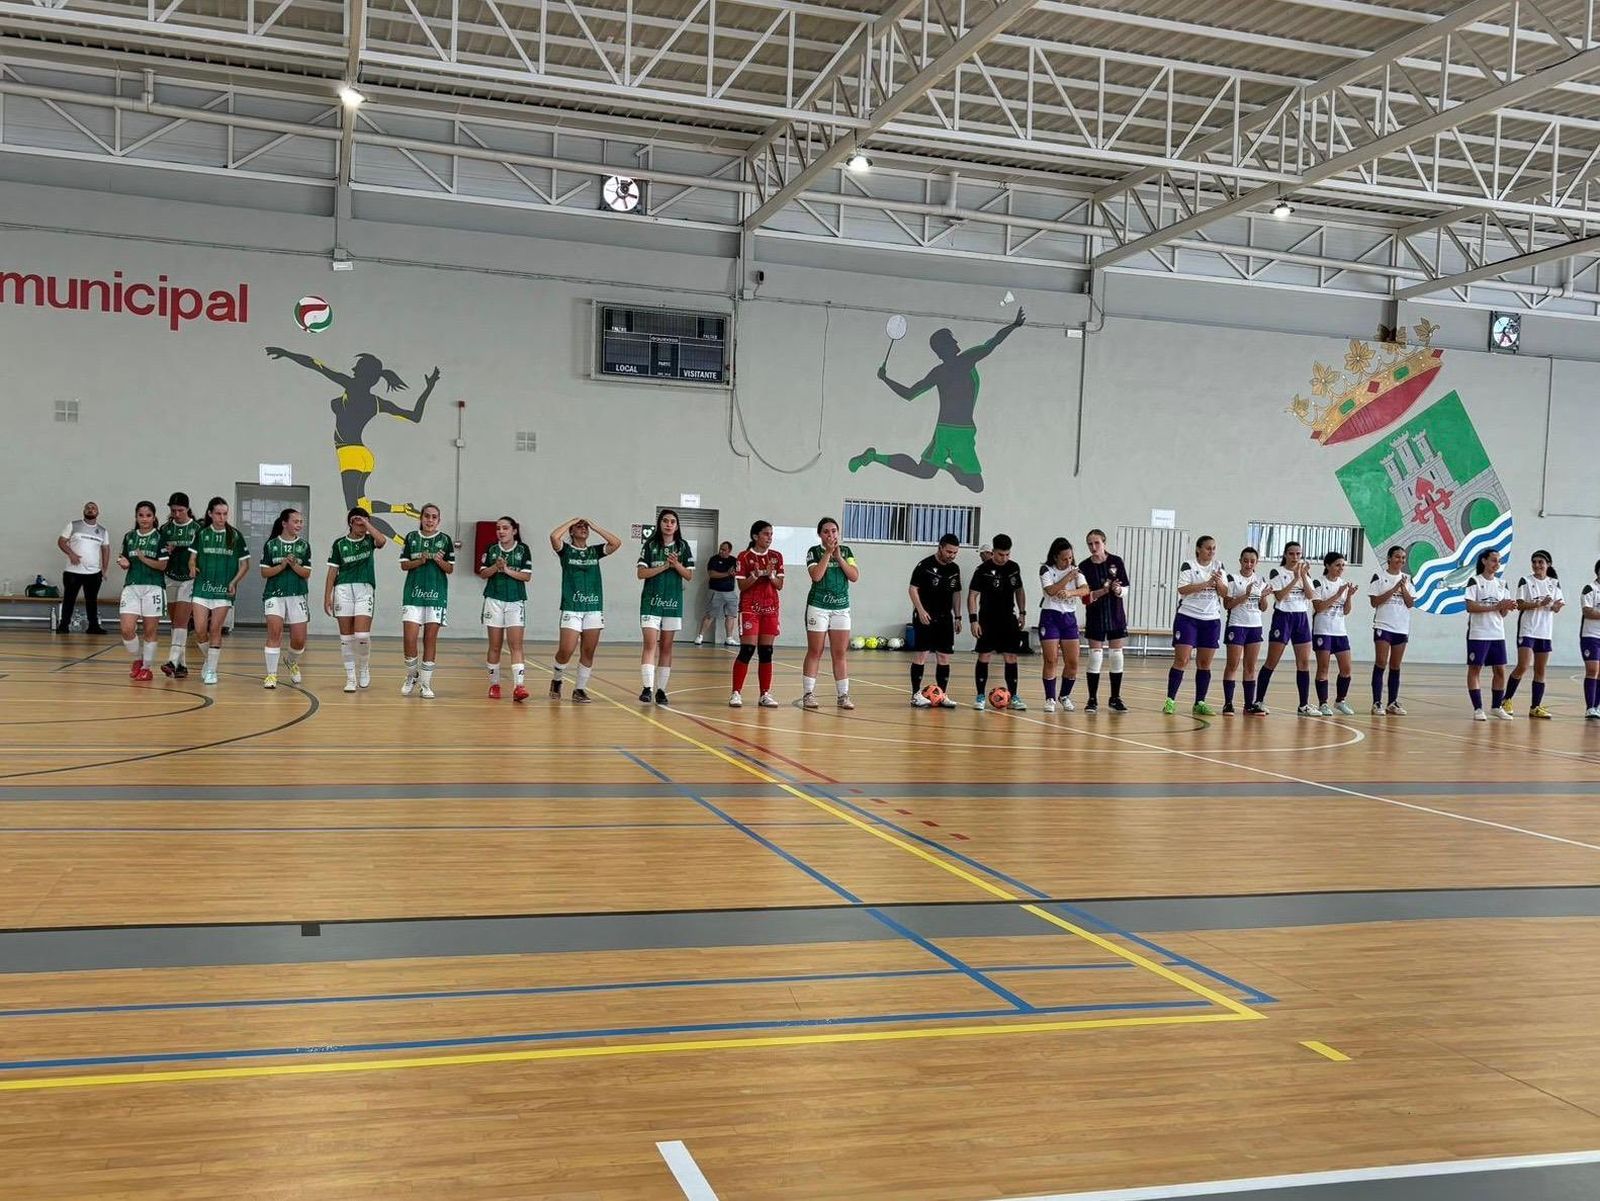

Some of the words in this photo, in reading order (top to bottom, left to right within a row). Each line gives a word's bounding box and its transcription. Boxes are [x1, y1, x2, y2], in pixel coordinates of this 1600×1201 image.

[0, 271, 248, 331] municipal
[615, 364, 638, 373] LOCAL
[683, 370, 717, 380] VISITANTE
[411, 584, 439, 598] Úbeda
[572, 591, 600, 603] Úbeda
[650, 594, 679, 608] Úbeda
